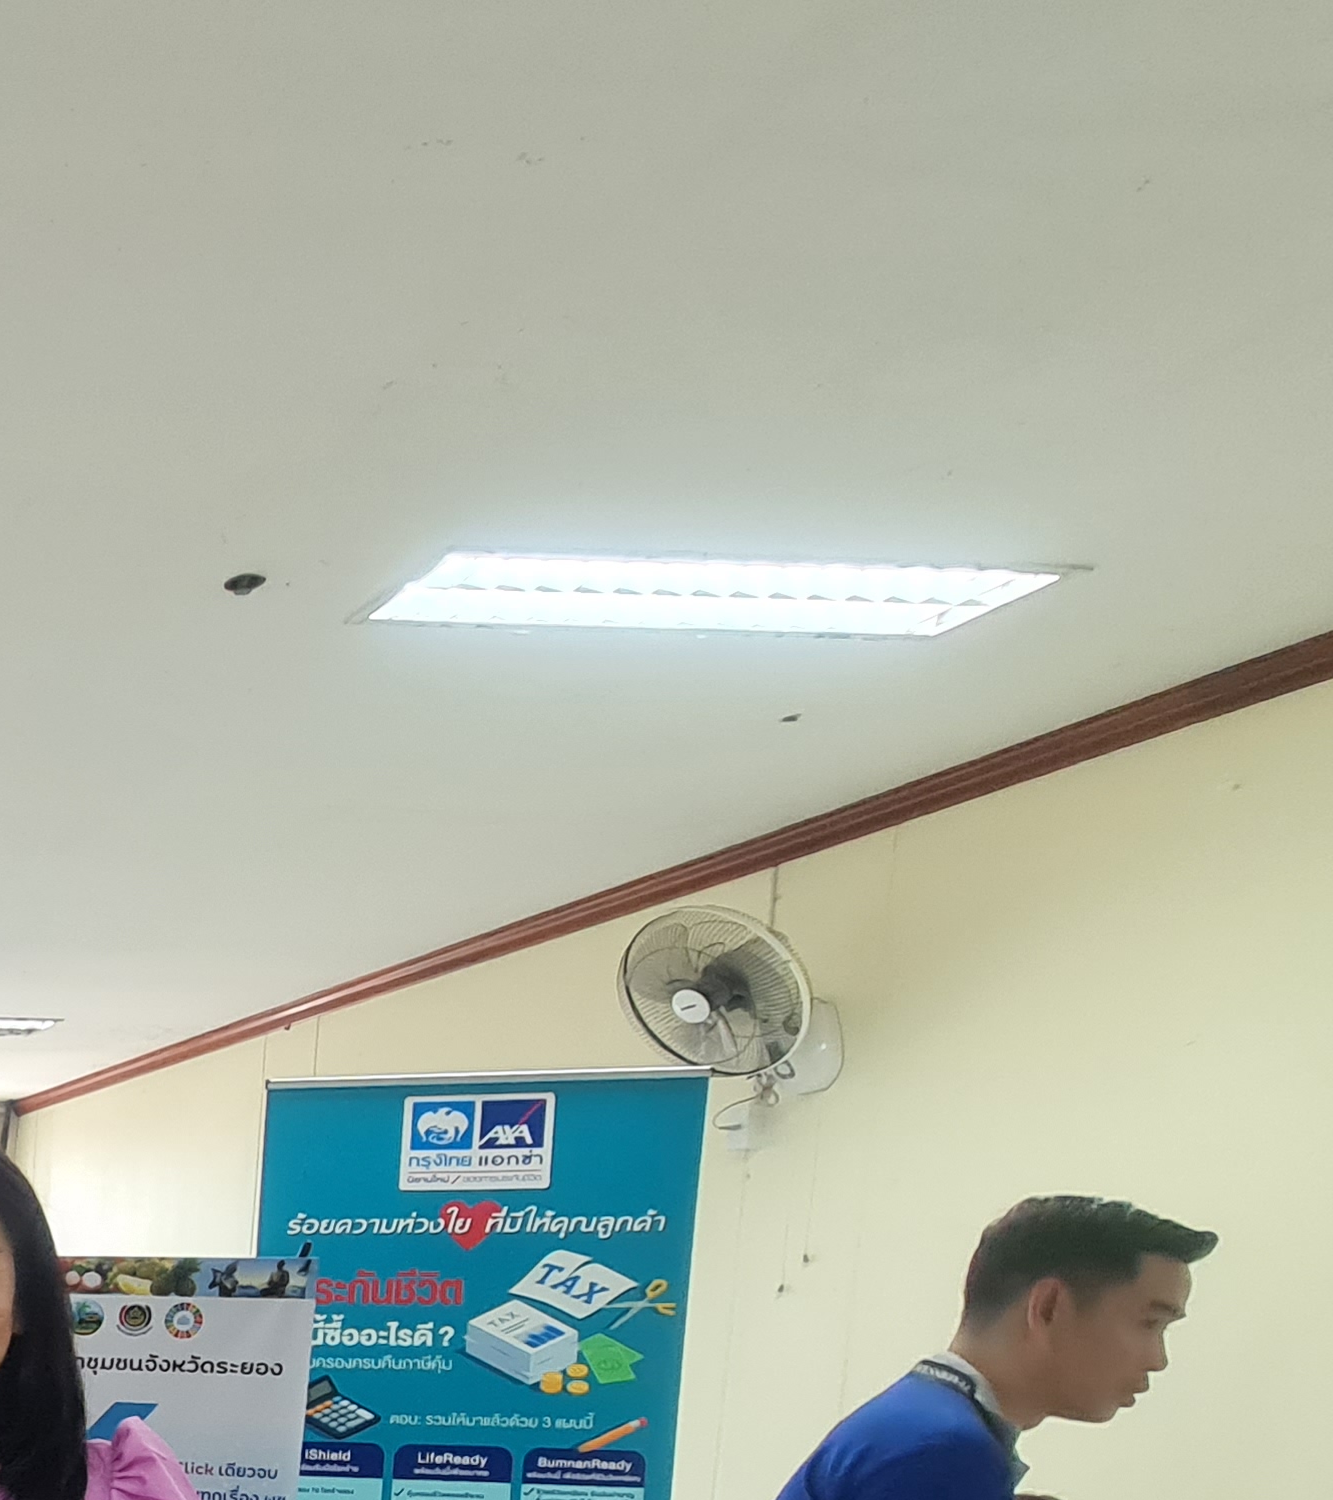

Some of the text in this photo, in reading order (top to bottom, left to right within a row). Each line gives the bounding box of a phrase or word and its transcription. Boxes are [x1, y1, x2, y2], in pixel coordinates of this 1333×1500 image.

[478, 1124, 533, 1147] AXA
[478, 1150, 543, 1167] แอกซ่า
[286, 1206, 667, 1240] ร้อยความห่วงใย ที่มีให้คุณลูกค้า
[535, 1264, 611, 1306] TAX
[179, 1461, 214, 1476] lick
